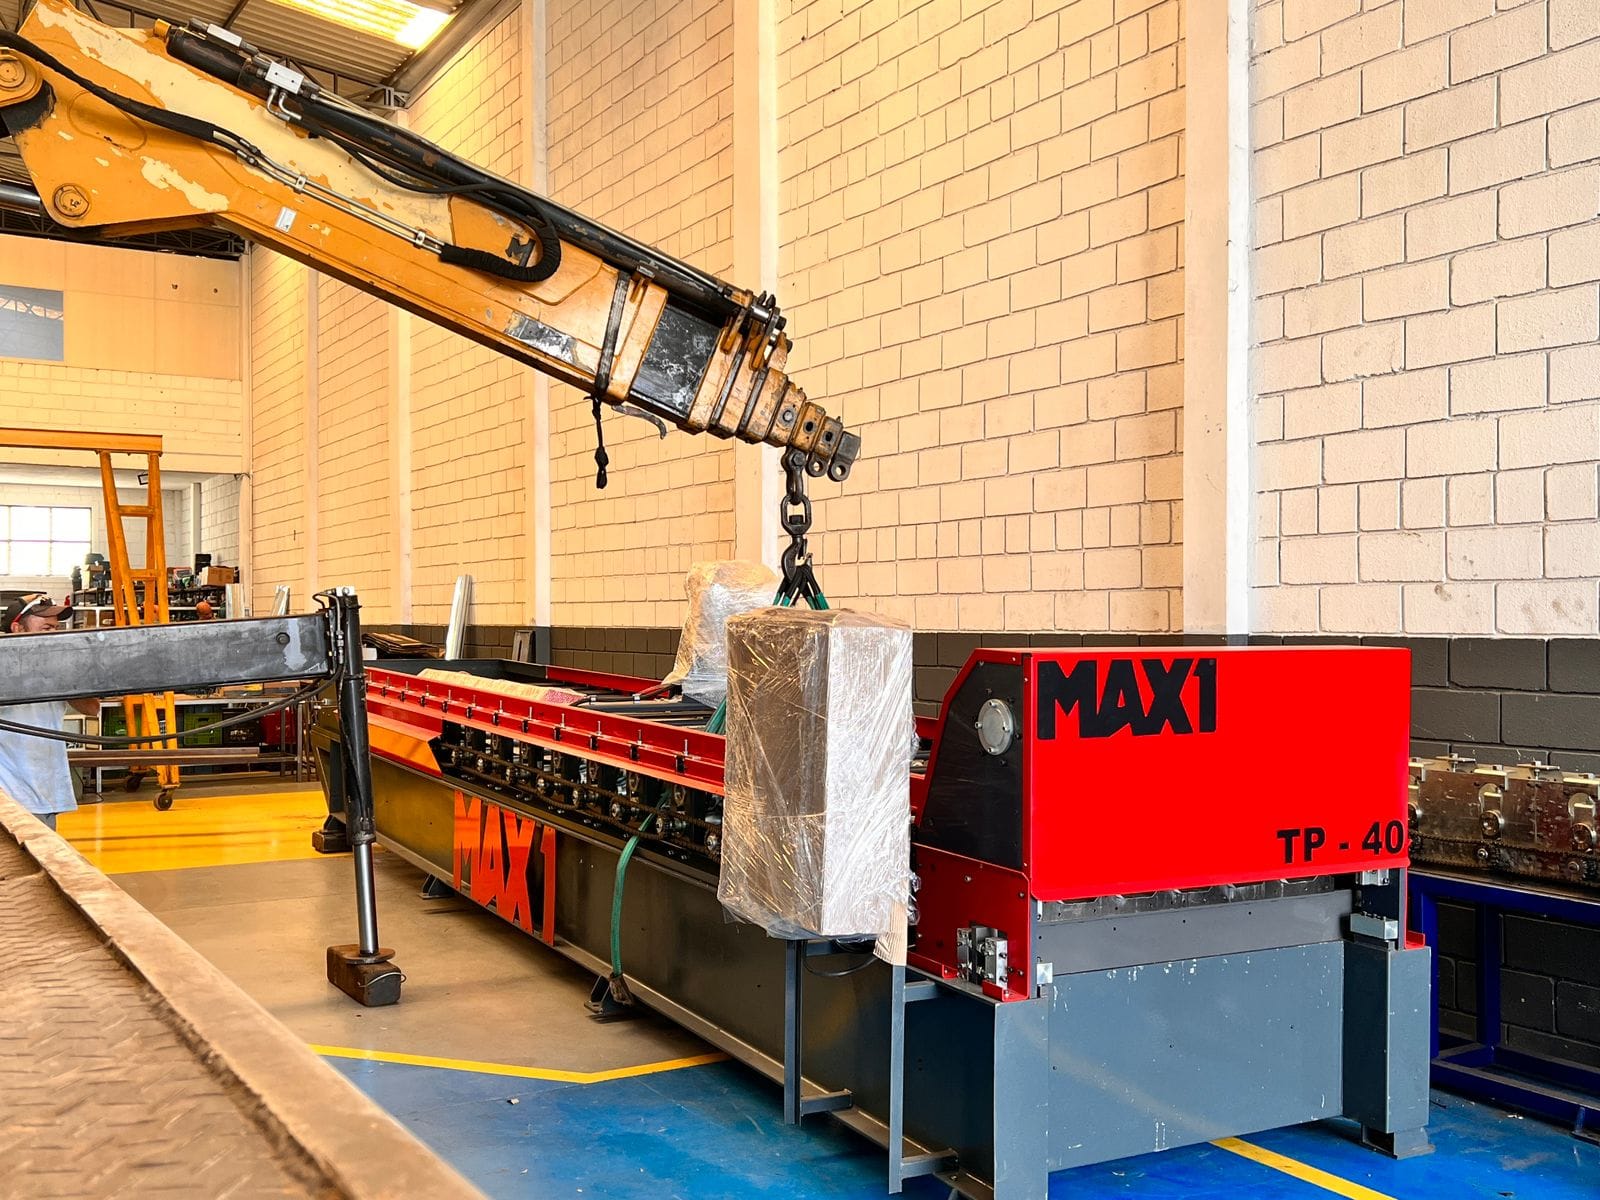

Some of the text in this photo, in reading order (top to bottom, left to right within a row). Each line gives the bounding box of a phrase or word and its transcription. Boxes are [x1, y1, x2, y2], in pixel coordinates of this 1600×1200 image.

[1037, 658, 1217, 740] MAX1
[1277, 828, 1326, 863] TP
[1362, 820, 1404, 855] 40
